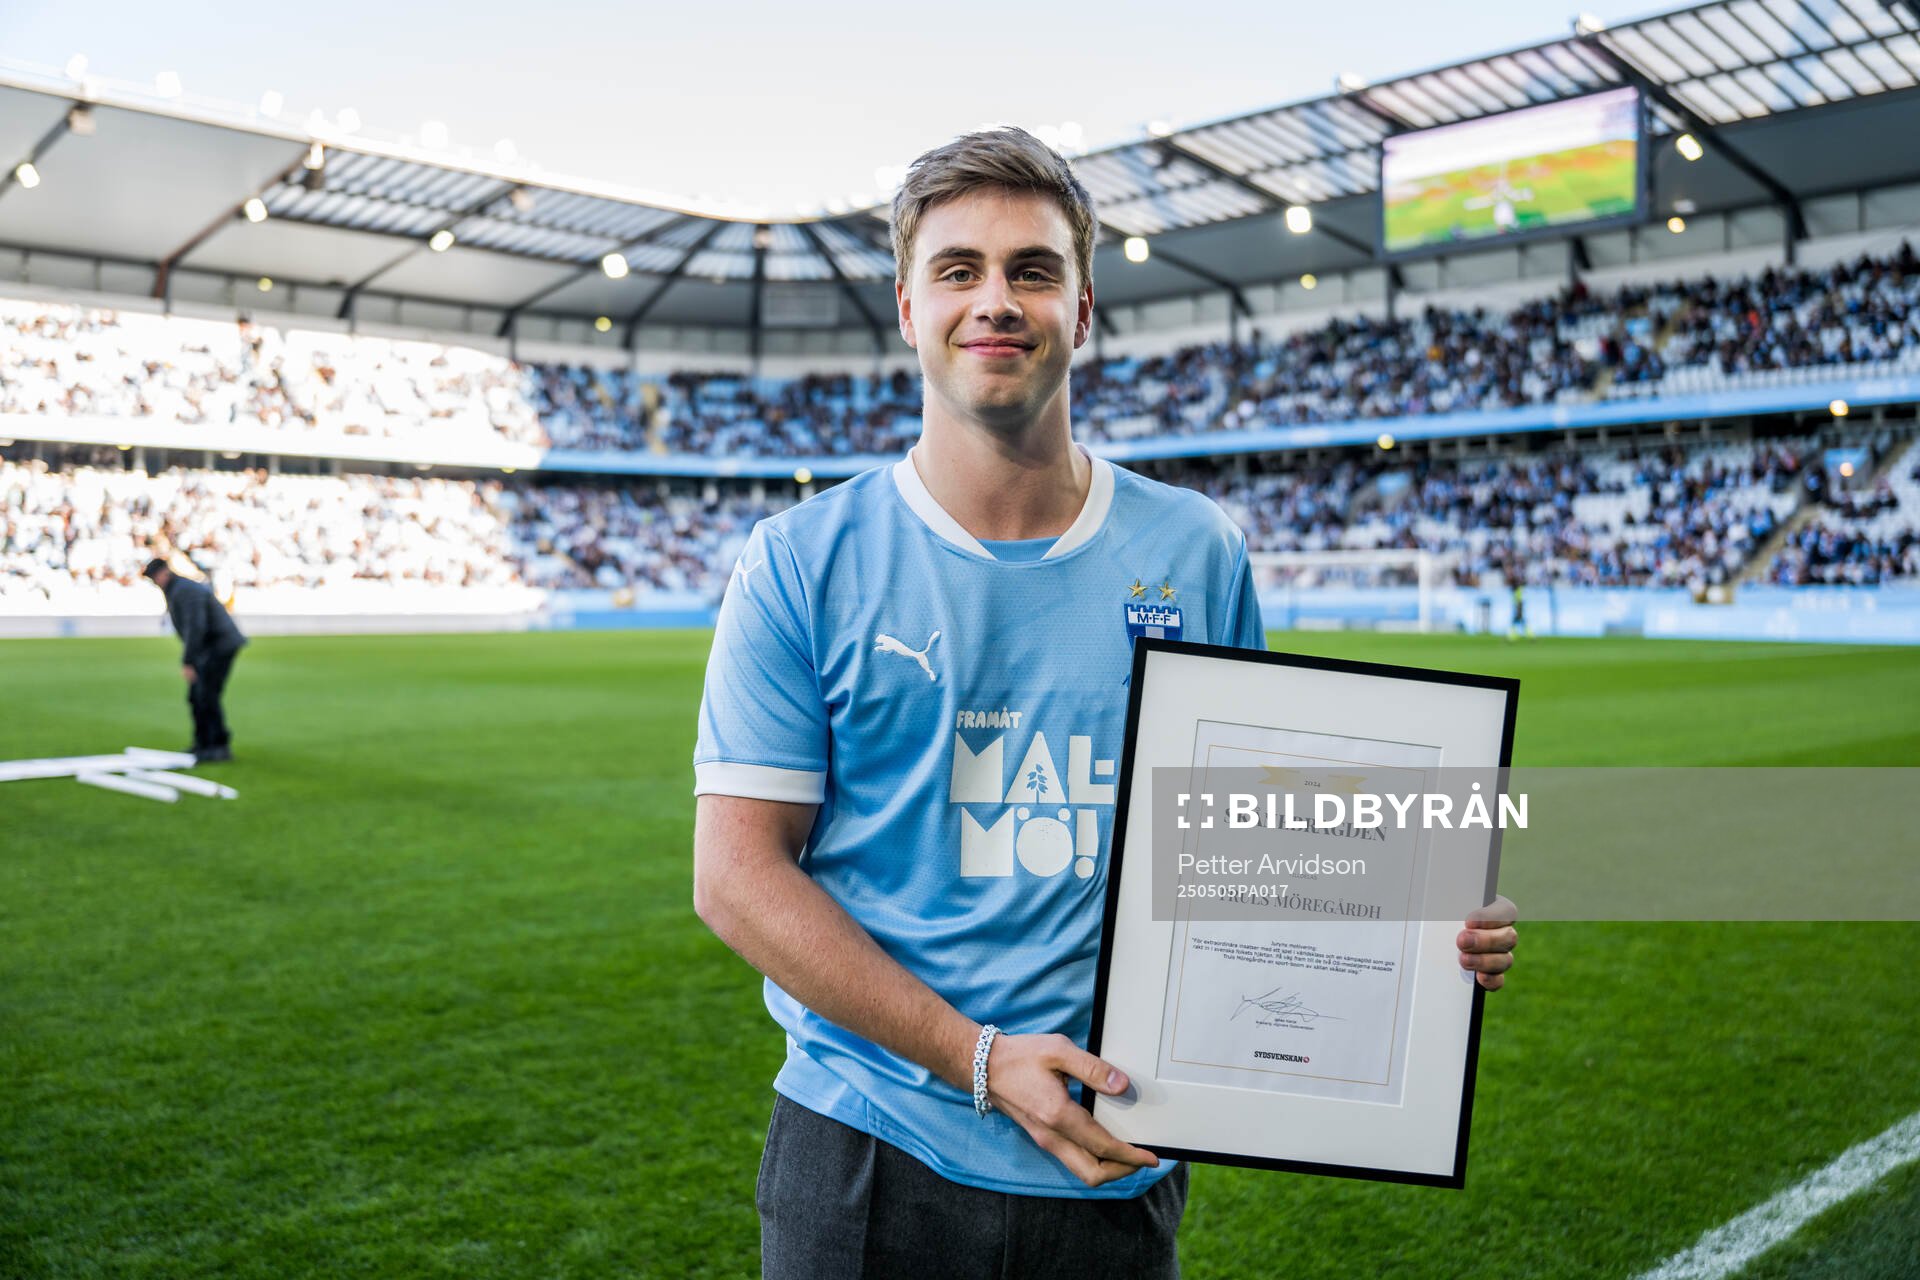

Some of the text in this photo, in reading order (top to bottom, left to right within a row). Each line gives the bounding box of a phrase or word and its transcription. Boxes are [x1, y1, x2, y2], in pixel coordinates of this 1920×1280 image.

[955, 705, 1023, 729] FRAMÅT
[1304, 780, 1321, 788] 2024
[960, 806, 1099, 879] MÖ!
[1273, 892, 1383, 919] MÖREGÅRDH
[1253, 1050, 1303, 1063] SYDSVENSKAN
